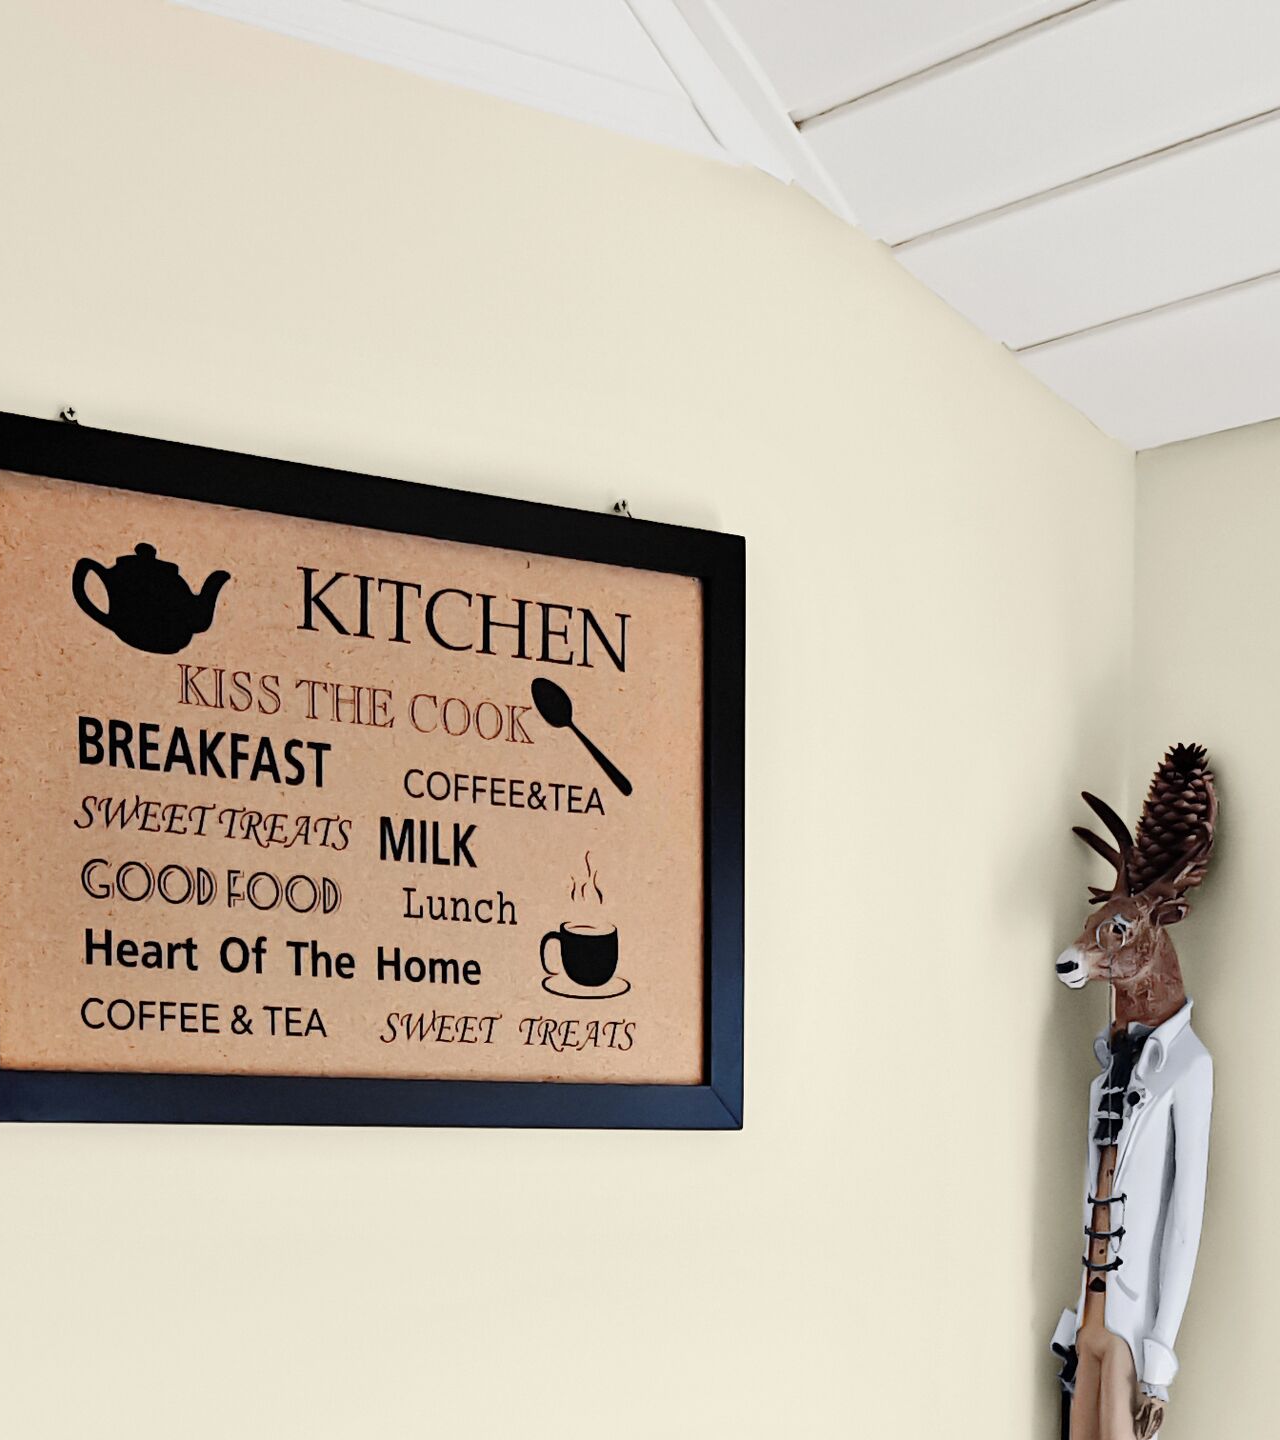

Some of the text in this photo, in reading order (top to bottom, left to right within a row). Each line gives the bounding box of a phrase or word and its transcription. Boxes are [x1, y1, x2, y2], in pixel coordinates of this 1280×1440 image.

[297, 566, 631, 672] KITCHEN
[177, 664, 534, 744] KISS THE COOK
[79, 716, 331, 787] BREAKFAST
[404, 769, 605, 815] COFFEE&TEA
[74, 795, 352, 851] SWEET TREATS
[380, 816, 477, 868] MILK
[81, 859, 342, 914] GOOD FOOD
[403, 887, 517, 925] Lunch
[85, 928, 481, 985] Heart Of The Home
[81, 998, 327, 1037] COFFEE & TEA
[380, 1010, 636, 1052] SWEET TREATS
